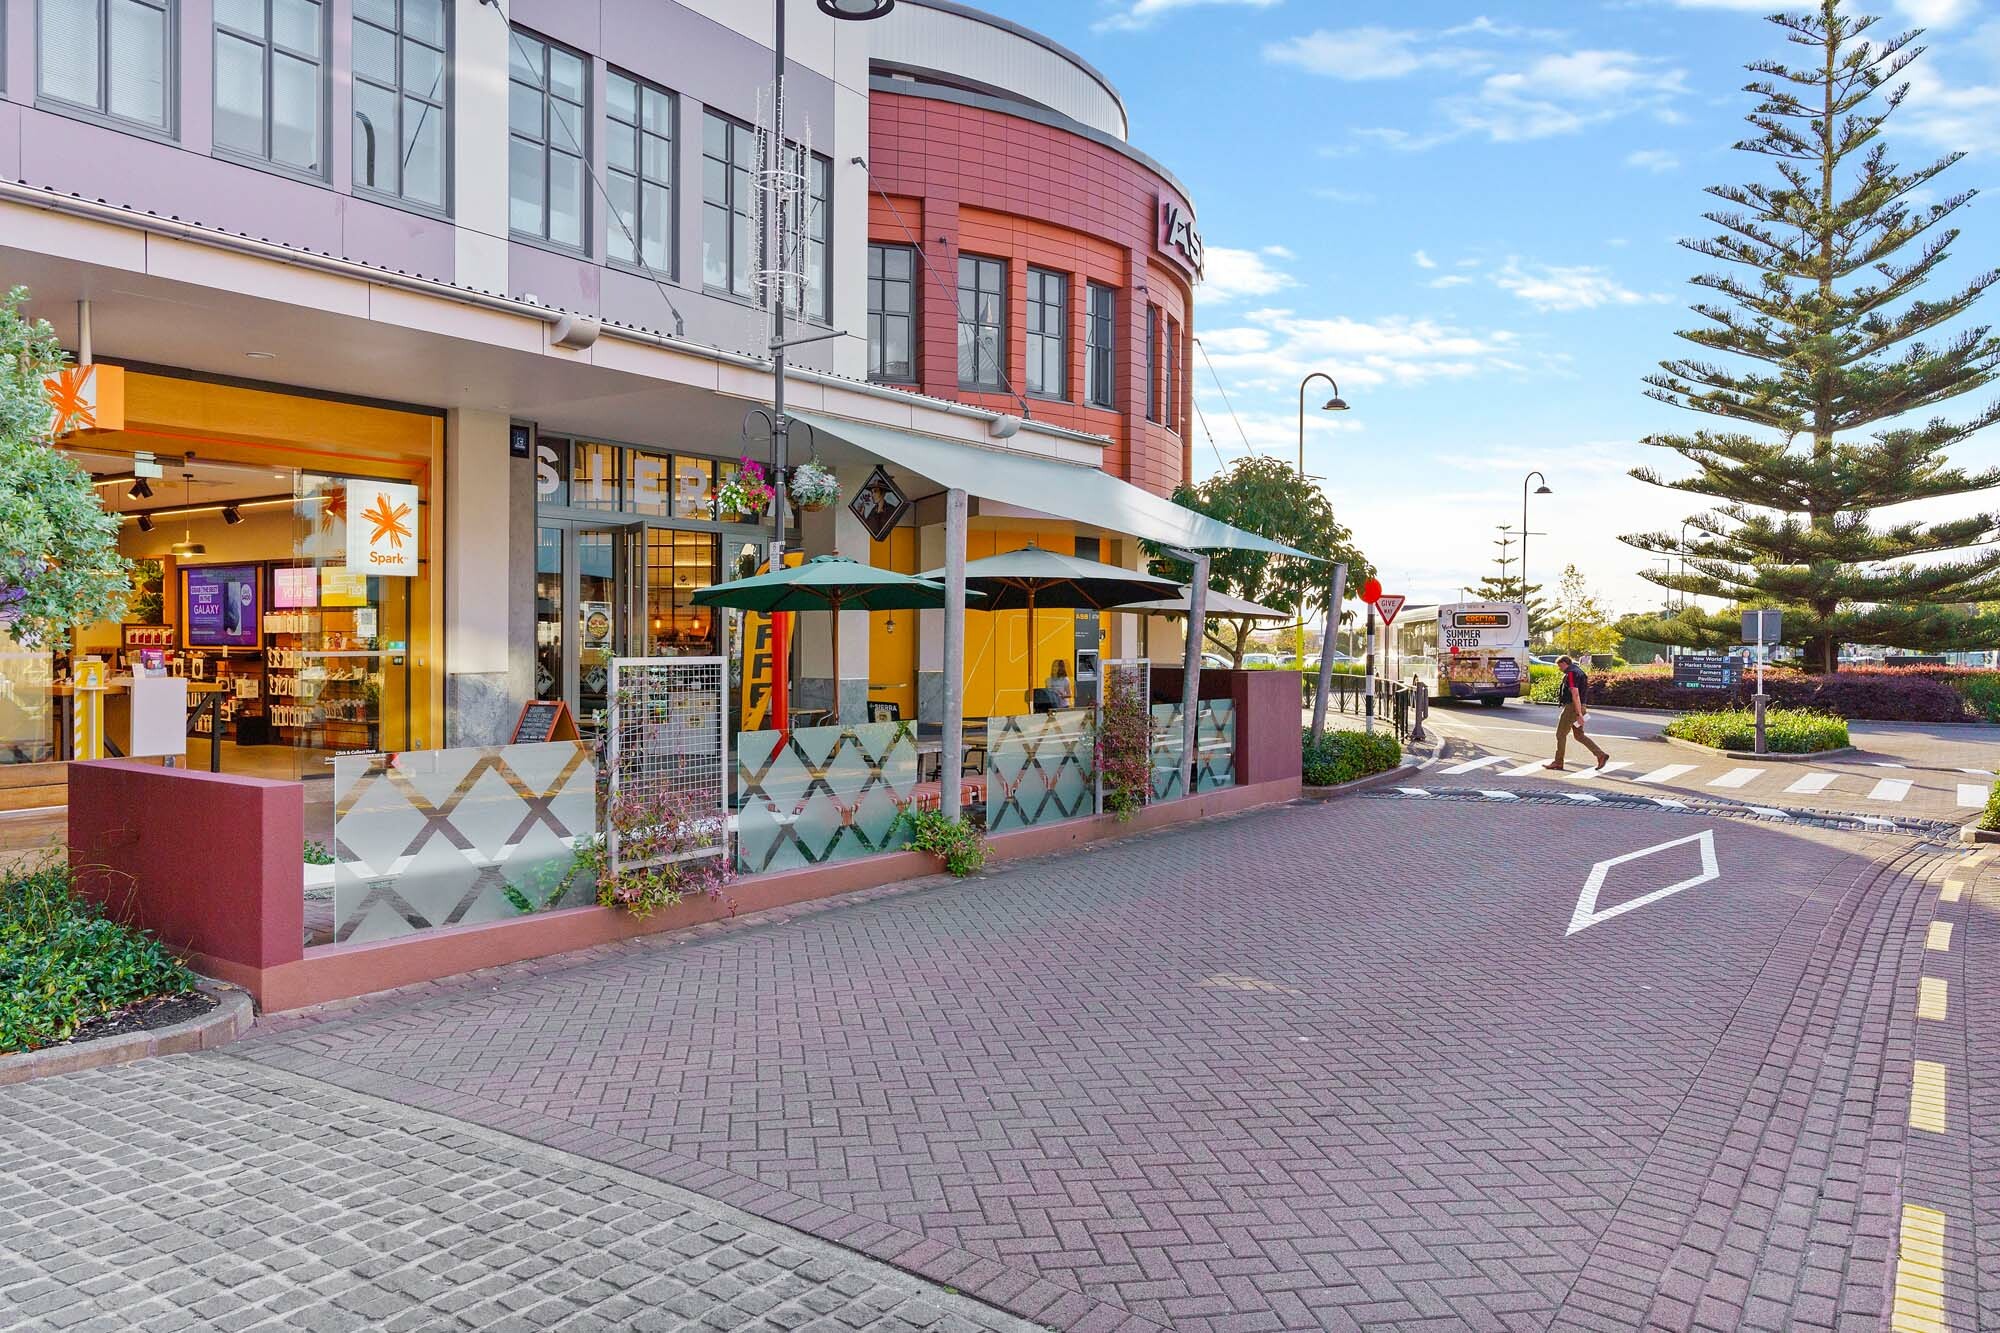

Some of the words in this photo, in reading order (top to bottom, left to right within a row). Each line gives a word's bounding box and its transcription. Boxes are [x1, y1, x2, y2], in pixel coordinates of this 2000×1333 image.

[369, 551, 404, 565] Spark
[194, 604, 220, 614] GALAXY
[1446, 630, 1480, 638] SUMMER
[1446, 639, 1479, 647] SORTED
[874, 703, 898, 711] SIERRA
